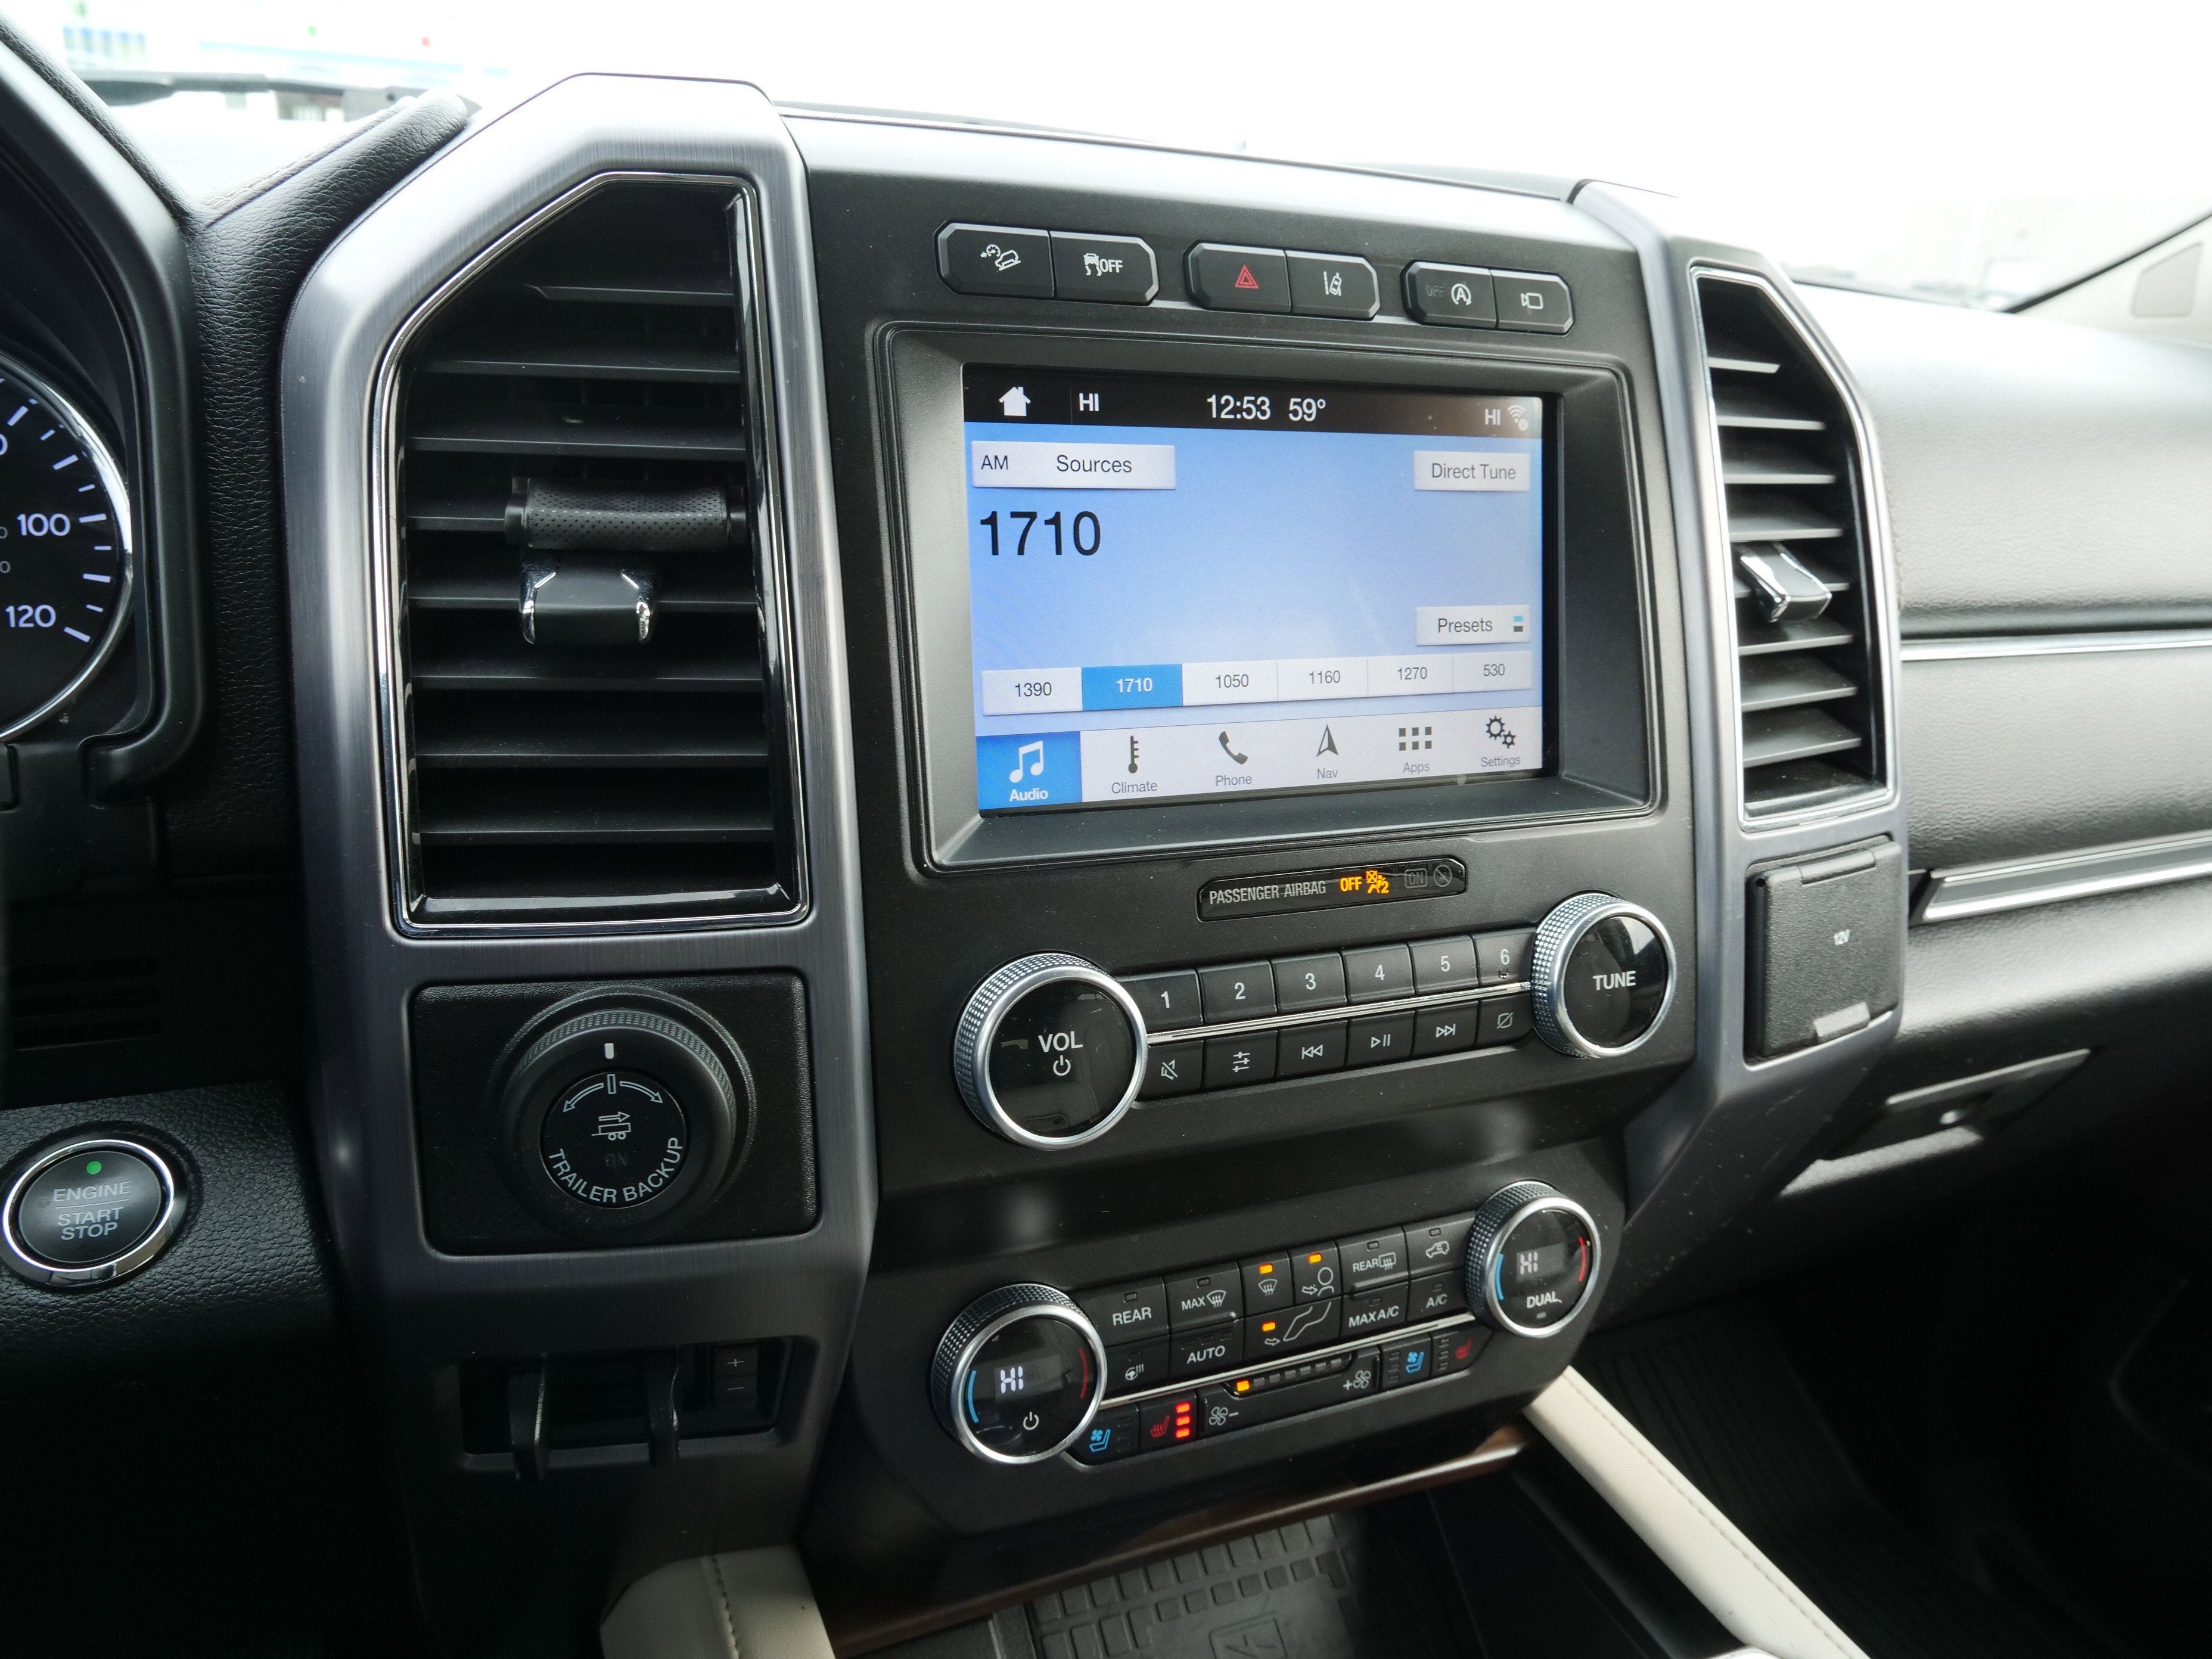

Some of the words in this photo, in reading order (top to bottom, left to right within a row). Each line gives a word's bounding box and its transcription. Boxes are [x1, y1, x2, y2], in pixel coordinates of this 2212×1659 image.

[1099, 259, 1123, 273] OFF
[1079, 393, 1099, 412] HI
[1207, 394, 1270, 420] 12:53
[1288, 397, 1326, 422] 59°
[1485, 408, 1501, 425] HI
[981, 455, 1009, 470] AM
[1056, 454, 1132, 473] Sources
[1431, 462, 1475, 479] Direct
[1480, 464, 1516, 480] Tune
[16, 513, 71, 536] 100
[980, 511, 1101, 556] 1710
[5, 604, 57, 628] 120
[1438, 617, 1493, 633] Presets
[1014, 682, 1052, 697] 1390
[1116, 678, 1153, 694] 1710
[1216, 673, 1249, 689] 1050
[1309, 670, 1341, 685] 1160
[1397, 666, 1427, 681] 1270
[1483, 663, 1505, 677] 530
[1009, 787, 1048, 802] Audio
[1111, 781, 1158, 794] Climate
[1216, 774, 1252, 787] Phone
[1317, 768, 1338, 779] Nav
[1403, 762, 1430, 774] Apps
[1481, 756, 1521, 768] Settings
[1408, 871, 1424, 885] ON
[1209, 884, 1279, 905] PASSENGER
[1284, 881, 1326, 897] AIRBAG
[1340, 877, 1362, 893] OFF
[1161, 991, 1170, 1009] 1
[1234, 982, 1246, 1001] 2
[1305, 973, 1316, 990] 3
[1375, 964, 1385, 980] 4
[1440, 955, 1450, 972] 5
[1500, 949, 1511, 965] 6
[1593, 970, 1636, 990] TUNE
[1038, 1030, 1083, 1053] VOL
[549, 1148, 617, 1203] TRAILER
[622, 1137, 683, 1203] BACKUP
[53, 1180, 132, 1202] ENGINE
[57, 1207, 124, 1226] START
[61, 1222, 118, 1241] STOP
[1353, 1258, 1379, 1273] REAR
[1519, 1252, 1538, 1275] HI
[1182, 1297, 1206, 1310] MAX
[1426, 1294, 1447, 1309] A/C
[1526, 1291, 1559, 1309] DUAL
[1113, 1307, 1152, 1326] REAR
[1349, 1313, 1377, 1328] MAX
[1377, 1307, 1399, 1321] A/C
[1186, 1346, 1225, 1365] AUTO
[1001, 1366, 1024, 1394] HI
